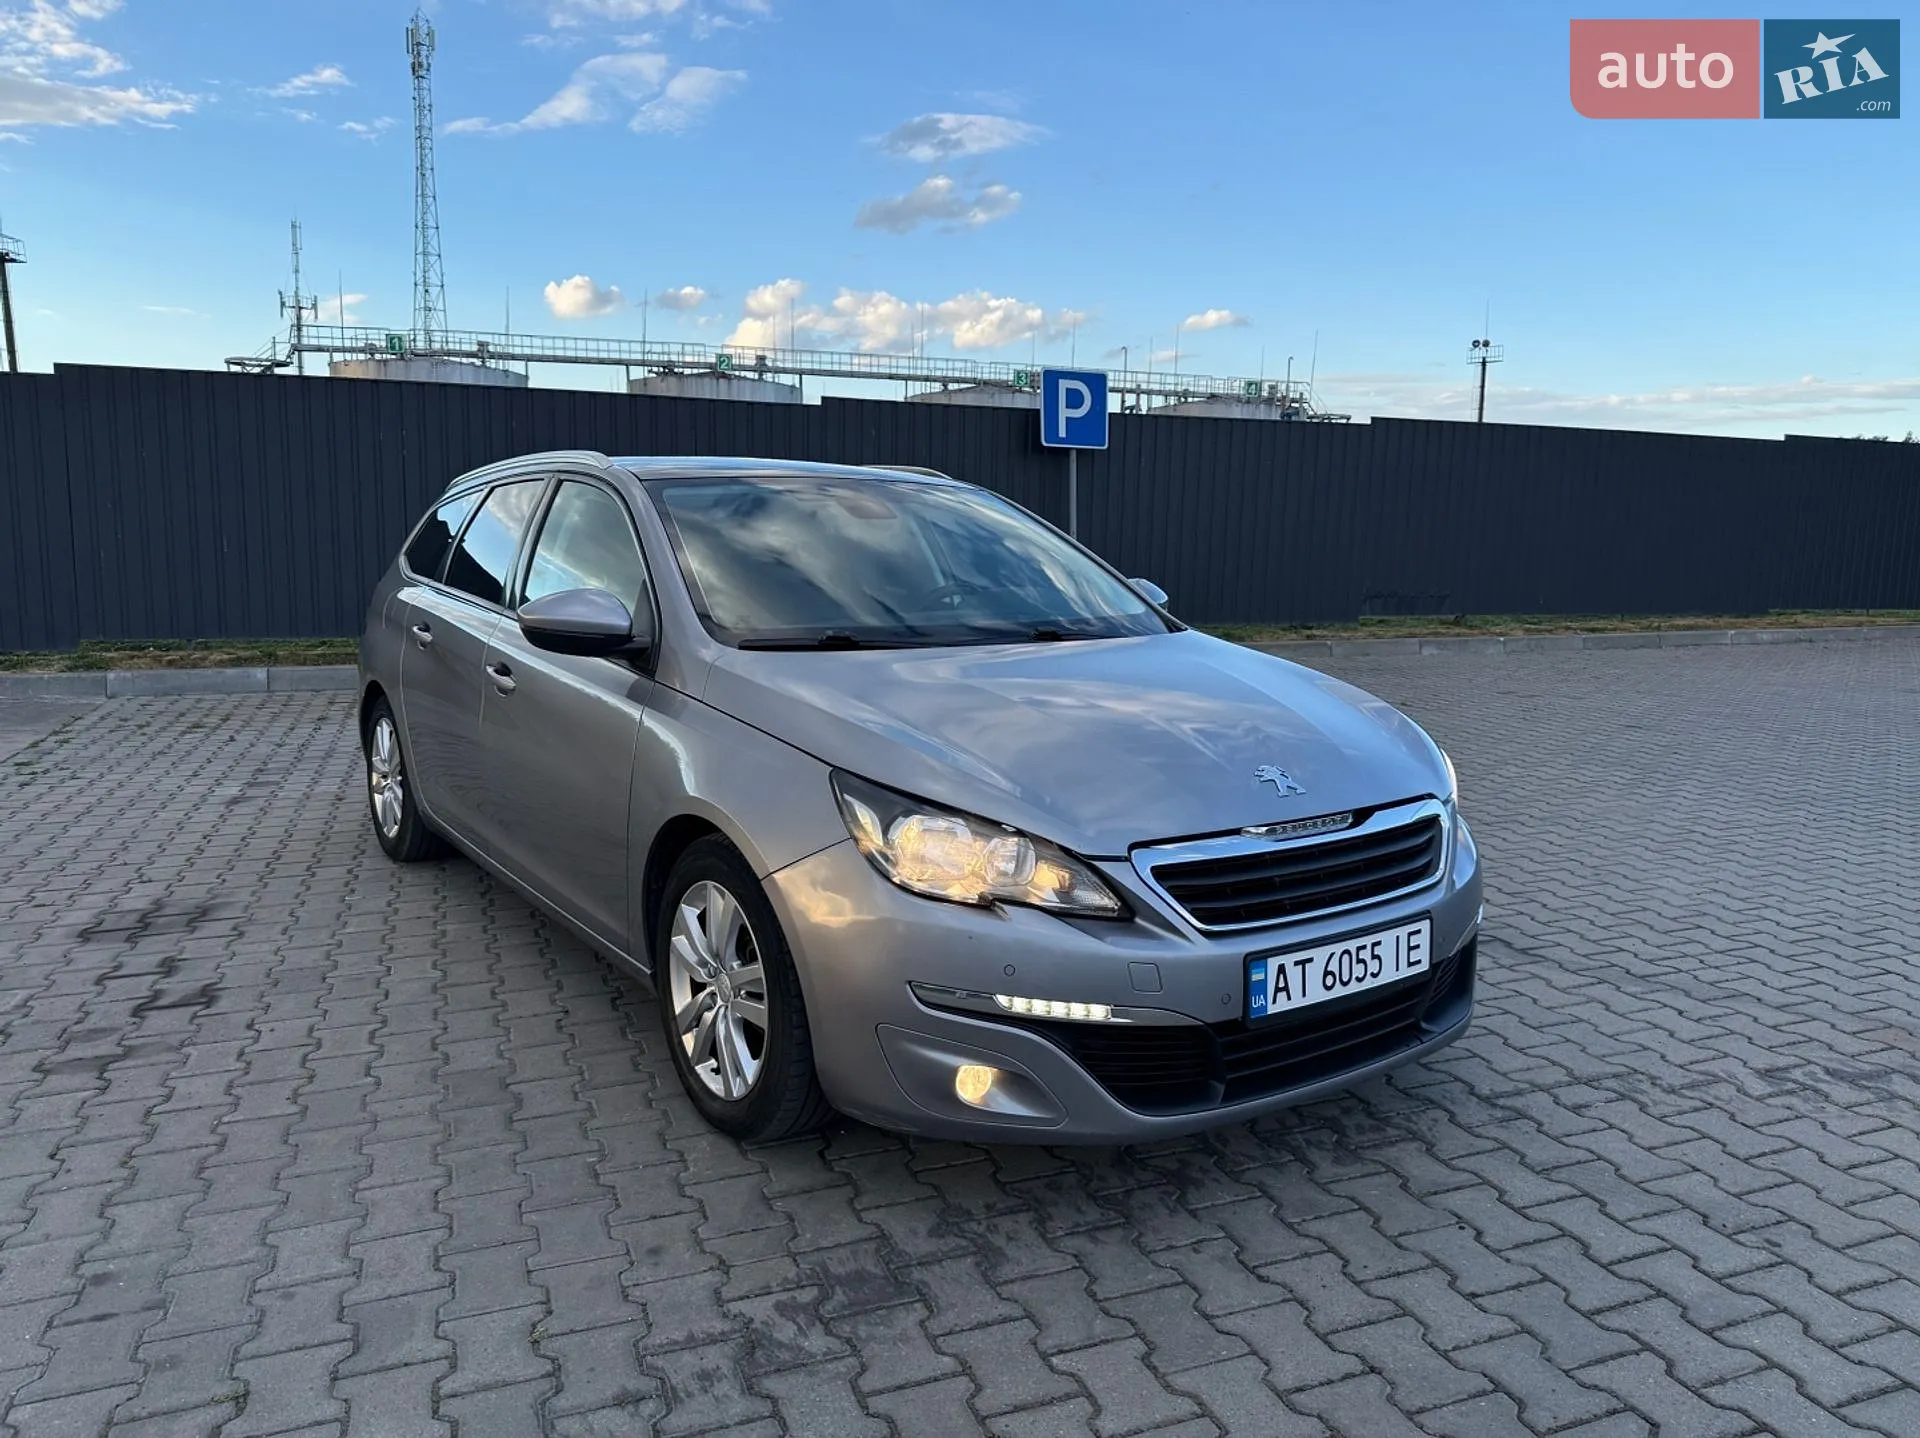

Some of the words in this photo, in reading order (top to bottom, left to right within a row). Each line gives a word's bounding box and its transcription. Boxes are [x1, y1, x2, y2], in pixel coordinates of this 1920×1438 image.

[1058, 378, 1092, 438] P
[1271, 957, 1315, 1005] AT
[1322, 940, 1383, 992] 6055
[1395, 928, 1422, 972] IE
[1251, 995, 1267, 1008] UA
